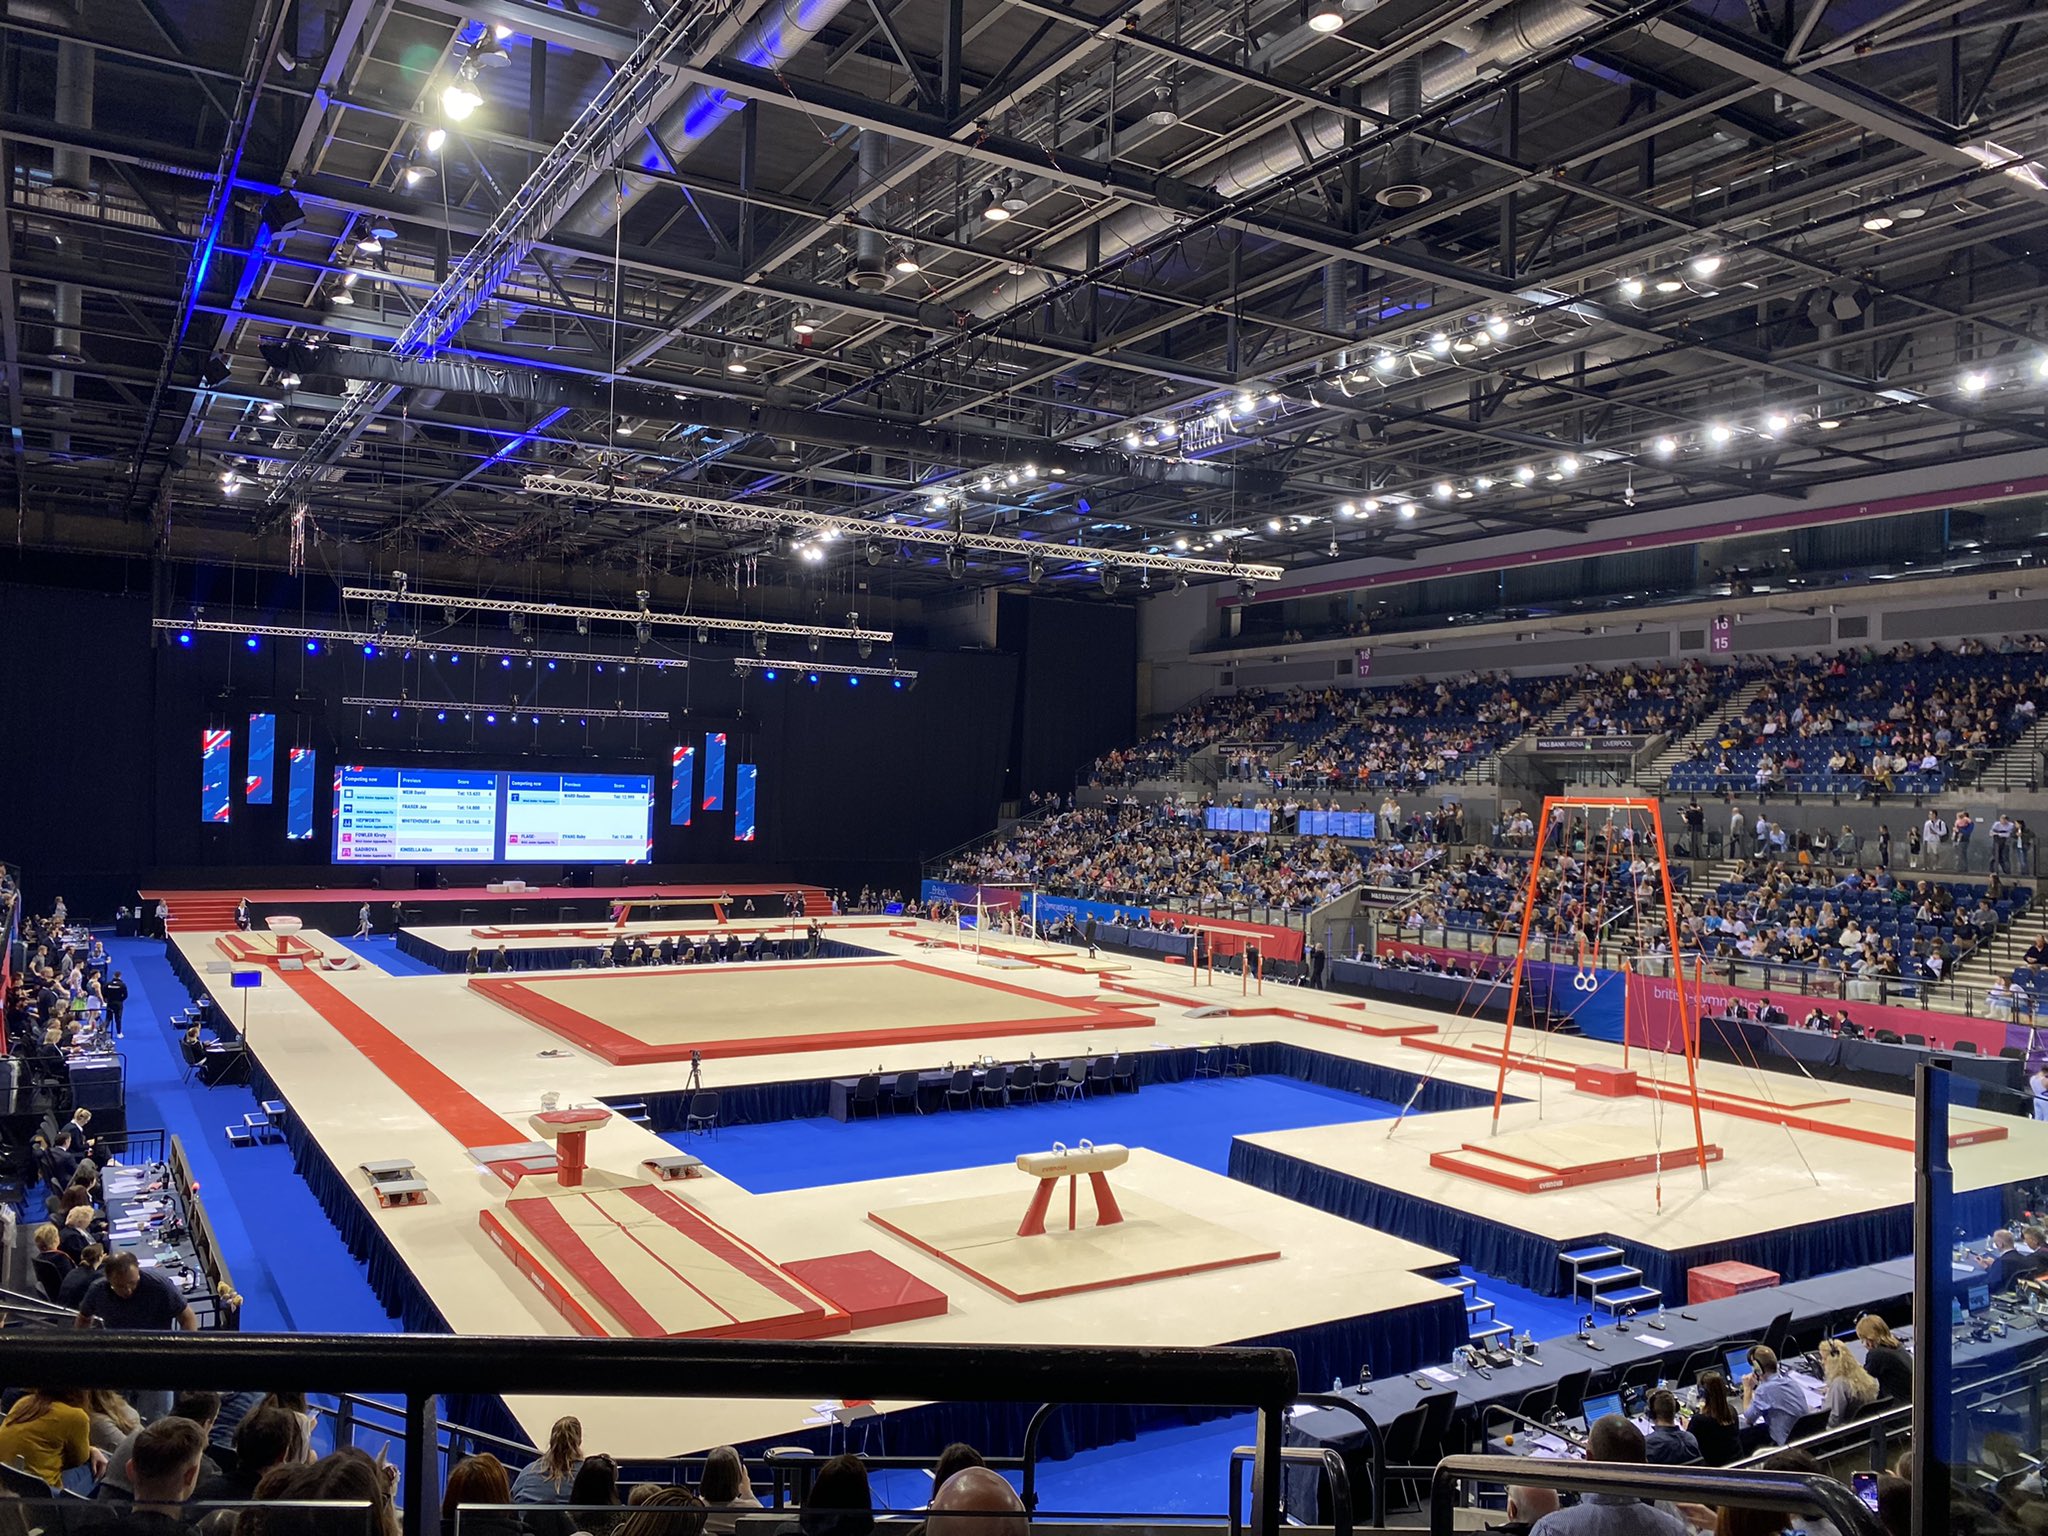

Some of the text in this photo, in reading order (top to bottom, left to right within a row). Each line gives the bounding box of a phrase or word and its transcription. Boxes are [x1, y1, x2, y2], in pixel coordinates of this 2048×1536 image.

[1714, 617, 1728, 630] 16
[1714, 637, 1728, 649] 15
[1360, 665, 1369, 675] 17
